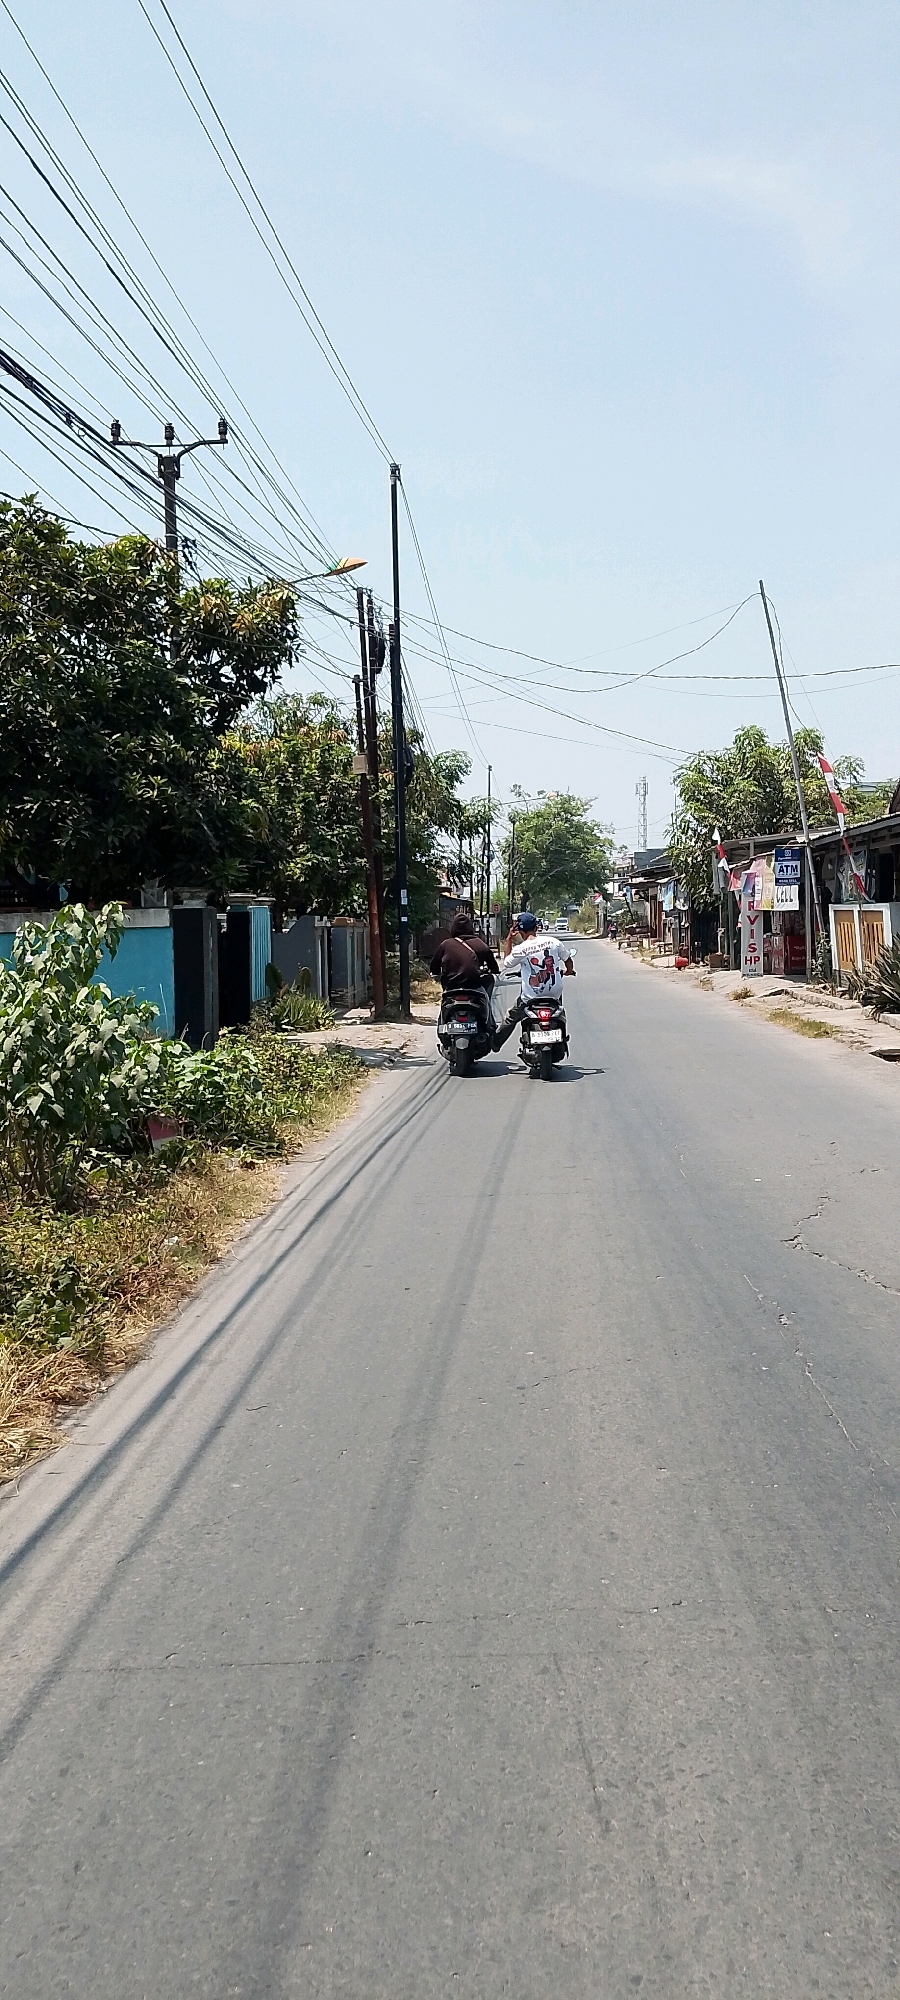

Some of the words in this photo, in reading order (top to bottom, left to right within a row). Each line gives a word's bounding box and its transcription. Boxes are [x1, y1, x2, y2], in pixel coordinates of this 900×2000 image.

[778, 864, 798, 874] ATM
[747, 901, 760, 953] RVIS
[745, 956, 760, 966] HP
